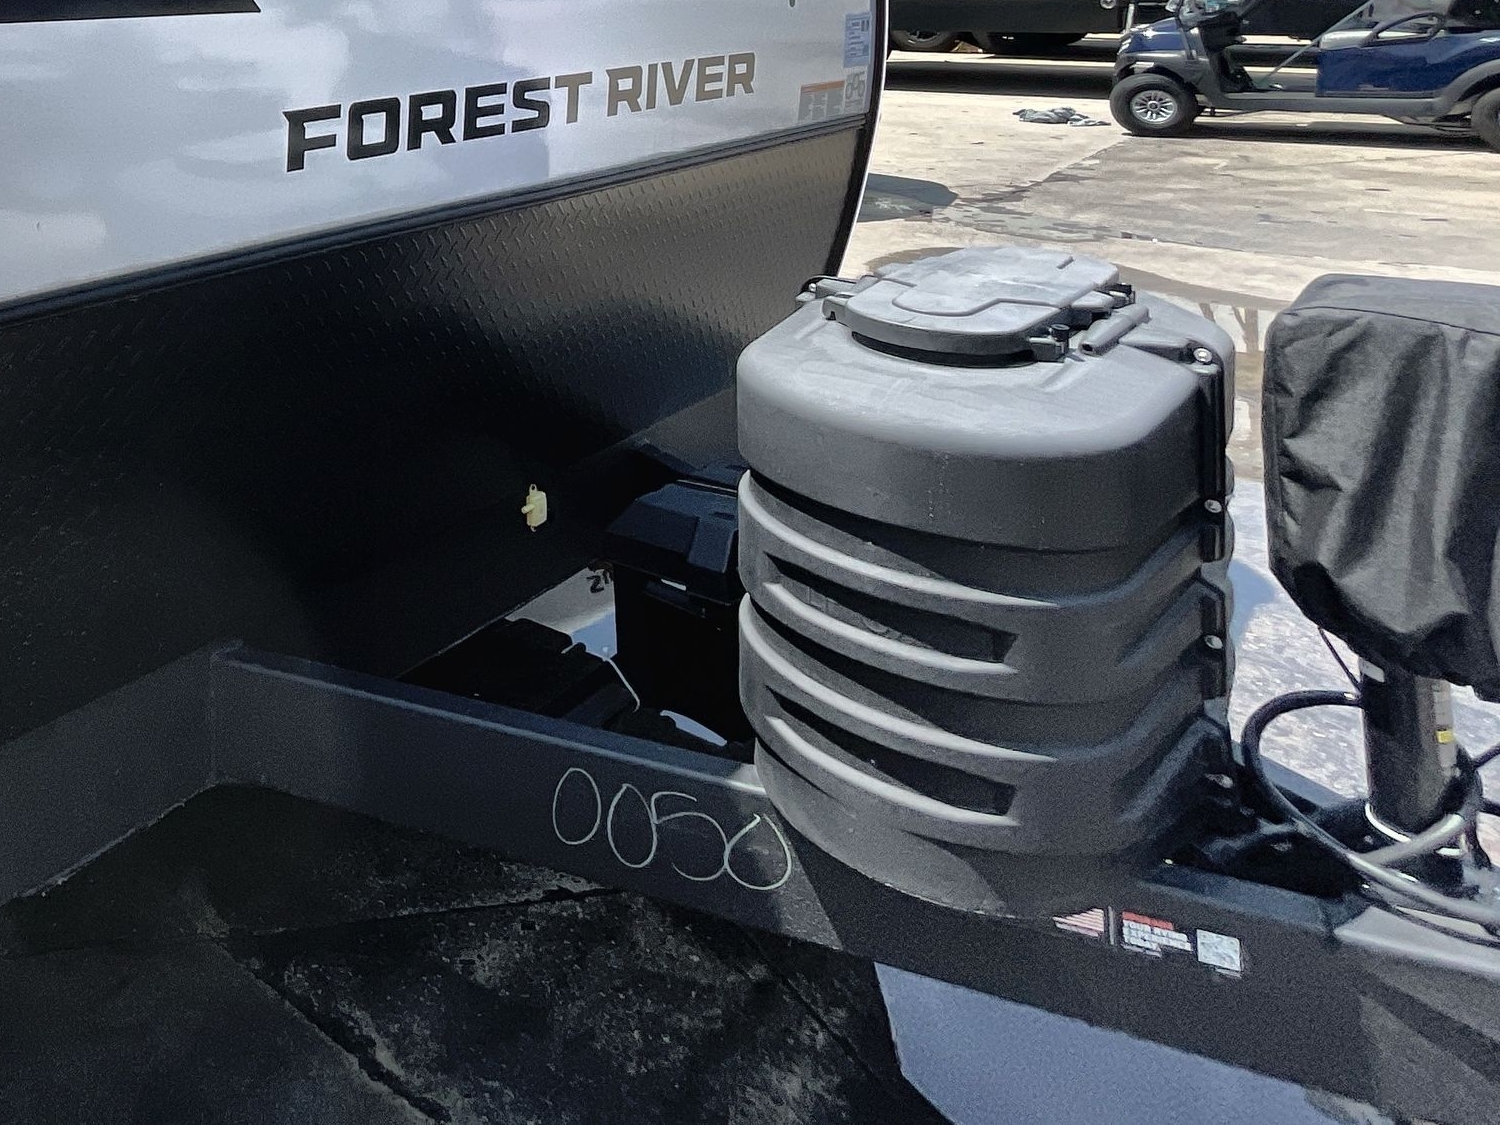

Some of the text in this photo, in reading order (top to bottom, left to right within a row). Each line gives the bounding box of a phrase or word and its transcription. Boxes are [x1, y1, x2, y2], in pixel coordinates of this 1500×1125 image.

[283, 72, 593, 173] FOREST
[605, 51, 756, 117] RIVER
[552, 766, 792, 891] 0050
